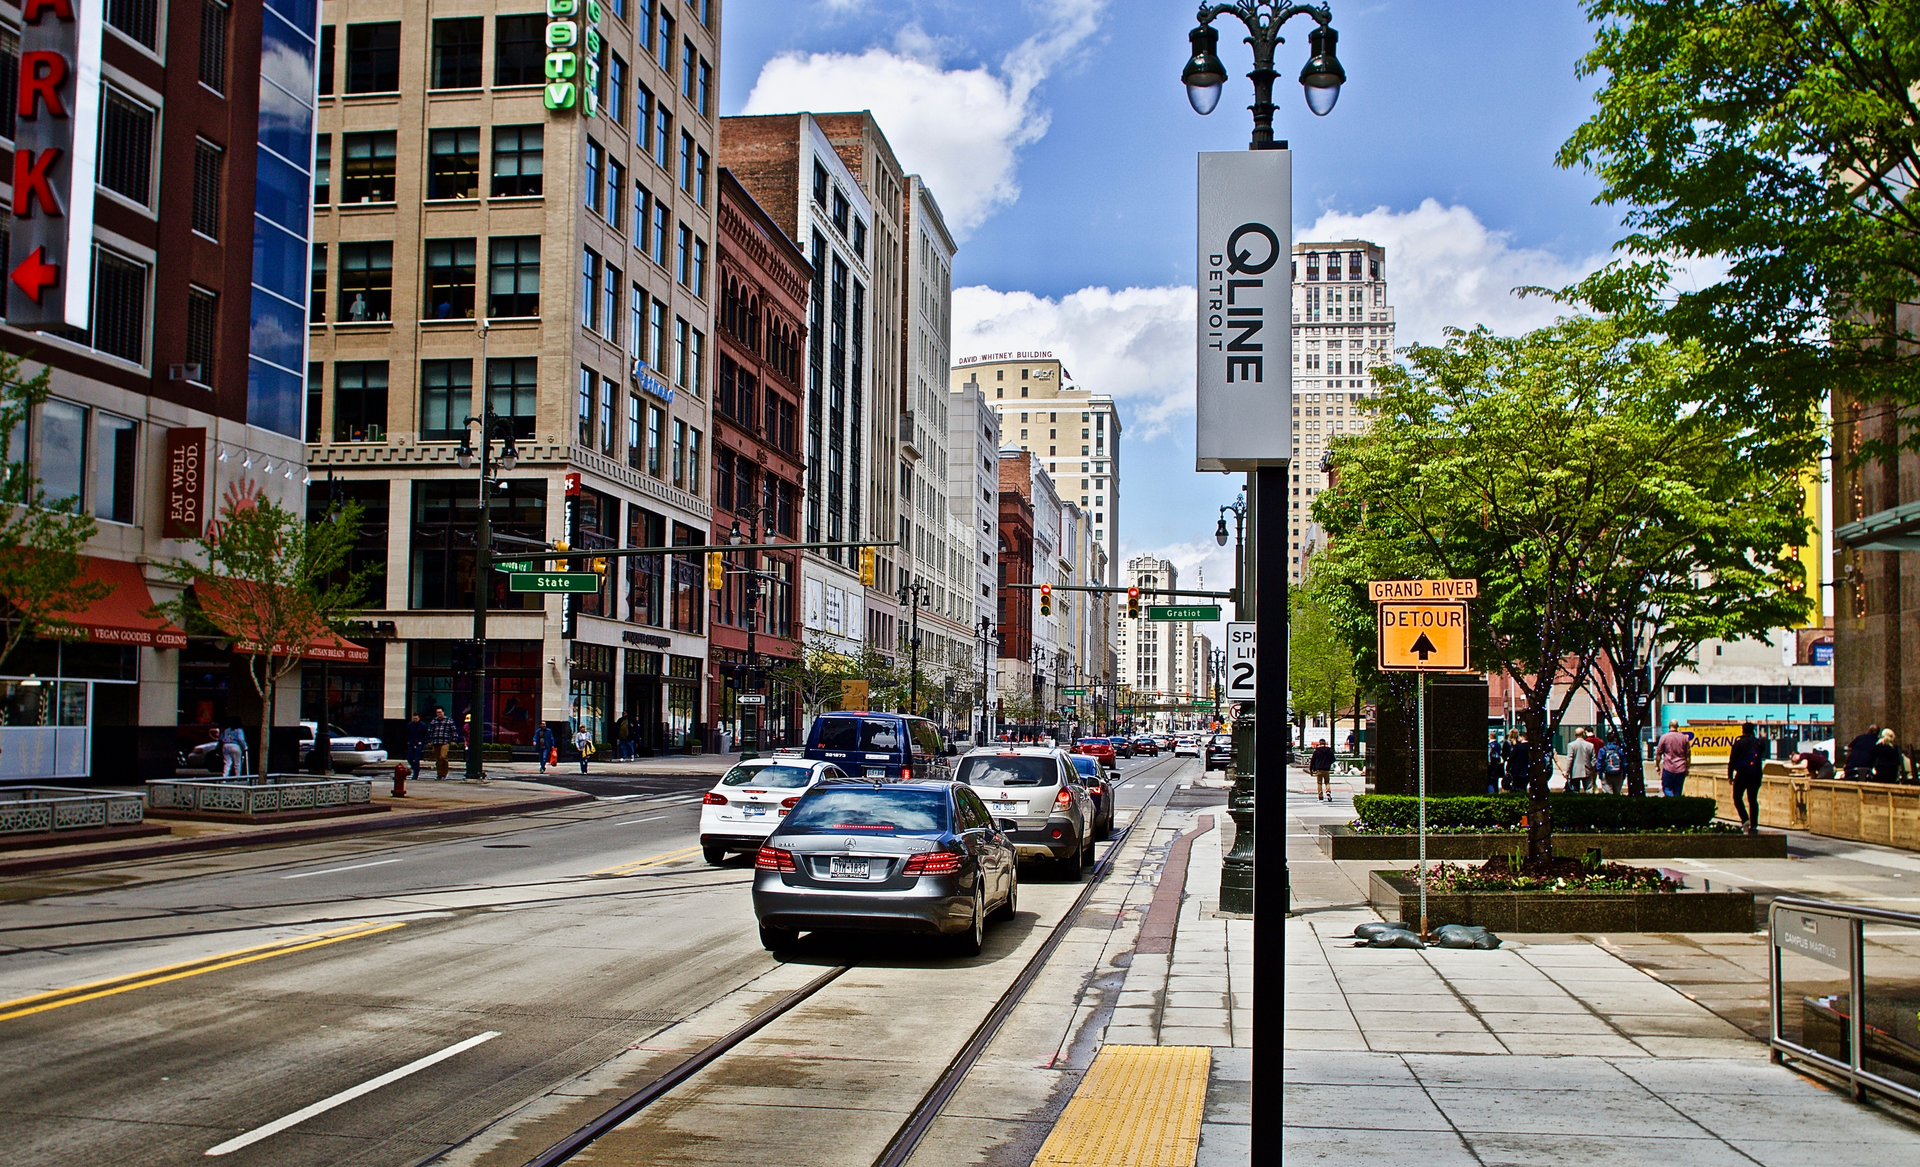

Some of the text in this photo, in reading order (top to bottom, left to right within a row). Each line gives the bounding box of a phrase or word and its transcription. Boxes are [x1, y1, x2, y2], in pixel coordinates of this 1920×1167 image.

[1208, 253, 1223, 352] DETROIT
[1226, 221, 1280, 384] QLINE
[959, 350, 1053, 364] DAVID WHITNEY BUILDING
[171, 445, 186, 520] EAT WELL
[184, 497, 196, 522] DO
[537, 577, 570, 588] State
[1374, 581, 1474, 597] GRAND RIVER
[1166, 609, 1201, 617] Gratiot
[1385, 611, 1462, 627] DETOUR
[95, 628, 120, 640] VEGAN
[121, 630, 151, 643] GOODIES
[156, 634, 187, 645] CATERING
[308, 648, 328, 657] ARTISAN
[328, 649, 345, 658] BREADS
[1682, 732, 1741, 748] PARKIN
[1784, 931, 1837, 959] CAMPUS MARTIUS
